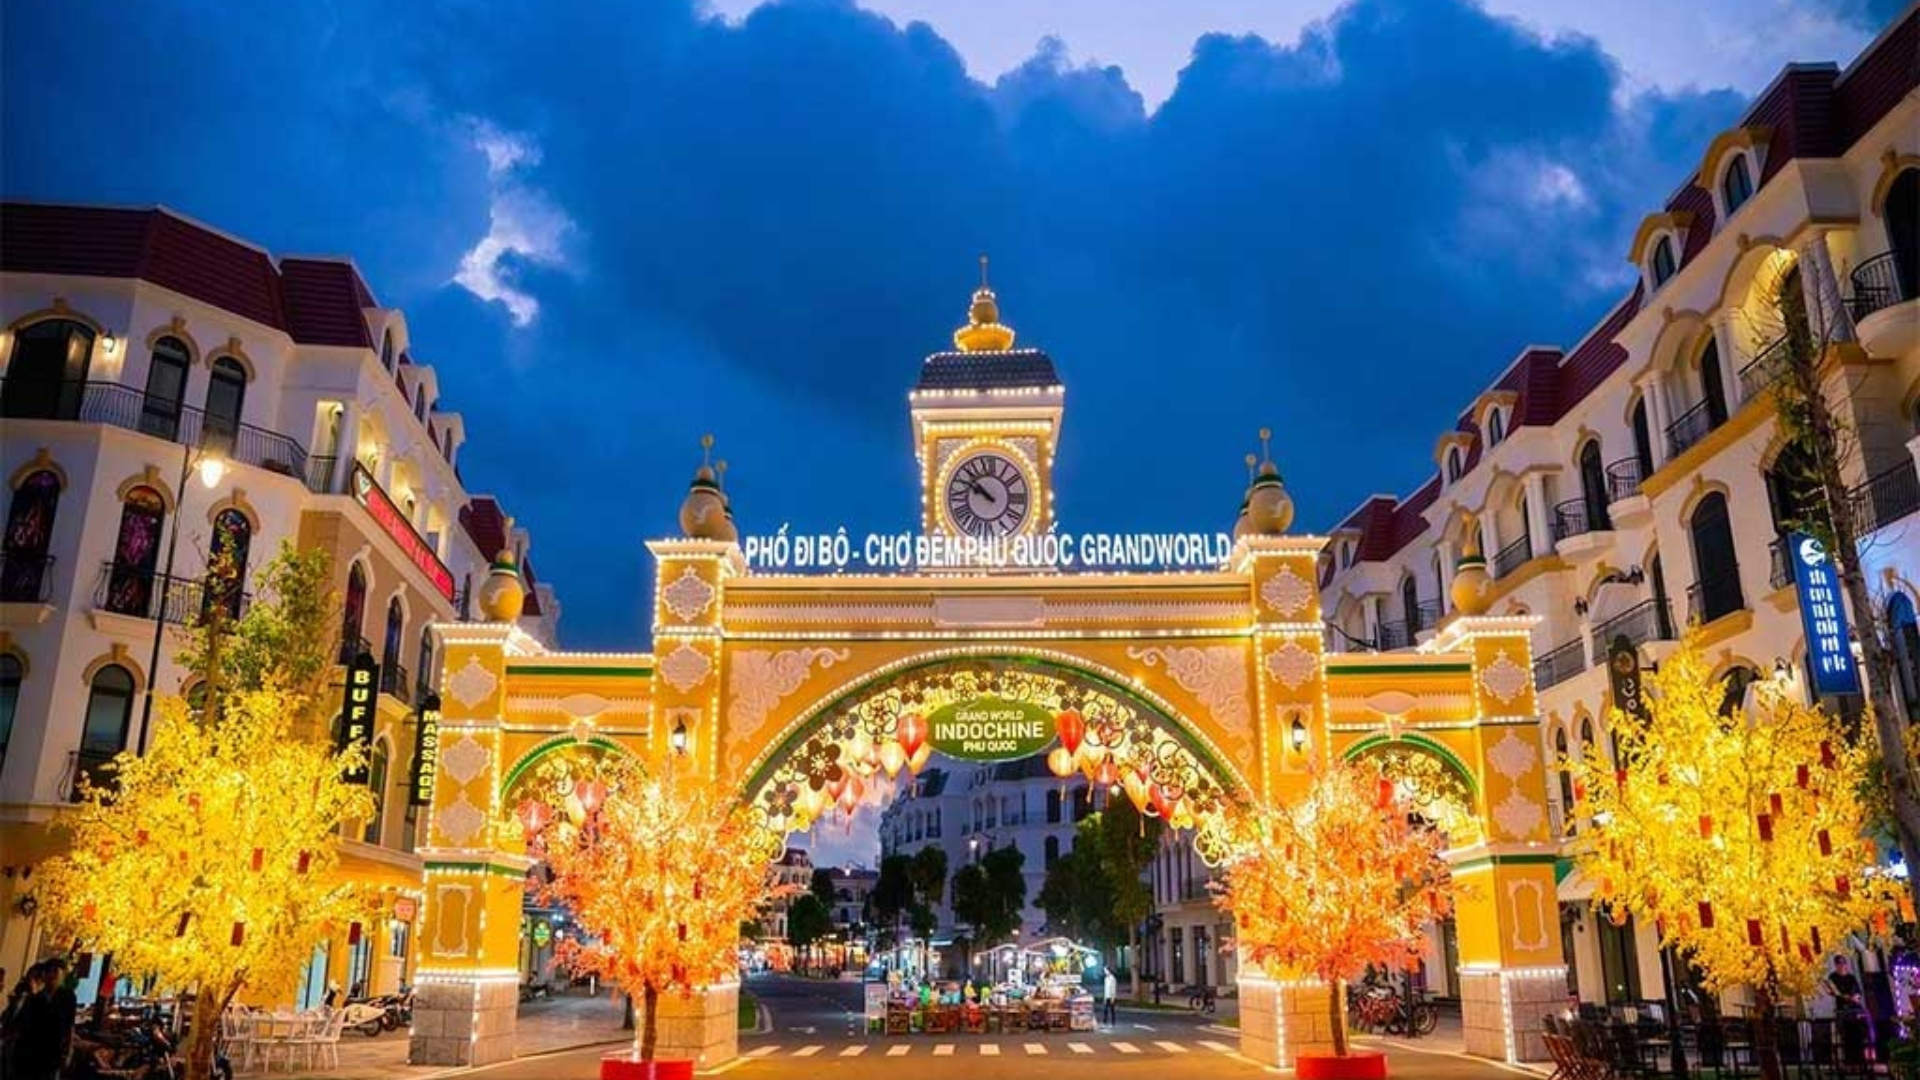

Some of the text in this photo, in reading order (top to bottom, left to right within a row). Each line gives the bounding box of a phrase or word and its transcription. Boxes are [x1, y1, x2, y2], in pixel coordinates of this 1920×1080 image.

[745, 523, 789, 567] PHỐ
[794, 536, 814, 566] ĐI
[818, 526, 849, 572] BỘ
[865, 531, 912, 572] CHỢ
[916, 528, 961, 566] ĐÊM
[1012, 521, 1073, 566] QUỐC
[1080, 533, 1231, 565] GRANDWORLD
[956, 710, 1024, 721] GRAND WORLD
[935, 721, 1044, 740] INDOCHINE
[418, 710, 437, 800] MASSAGE
[963, 741, 1017, 752] PHU QUOC
